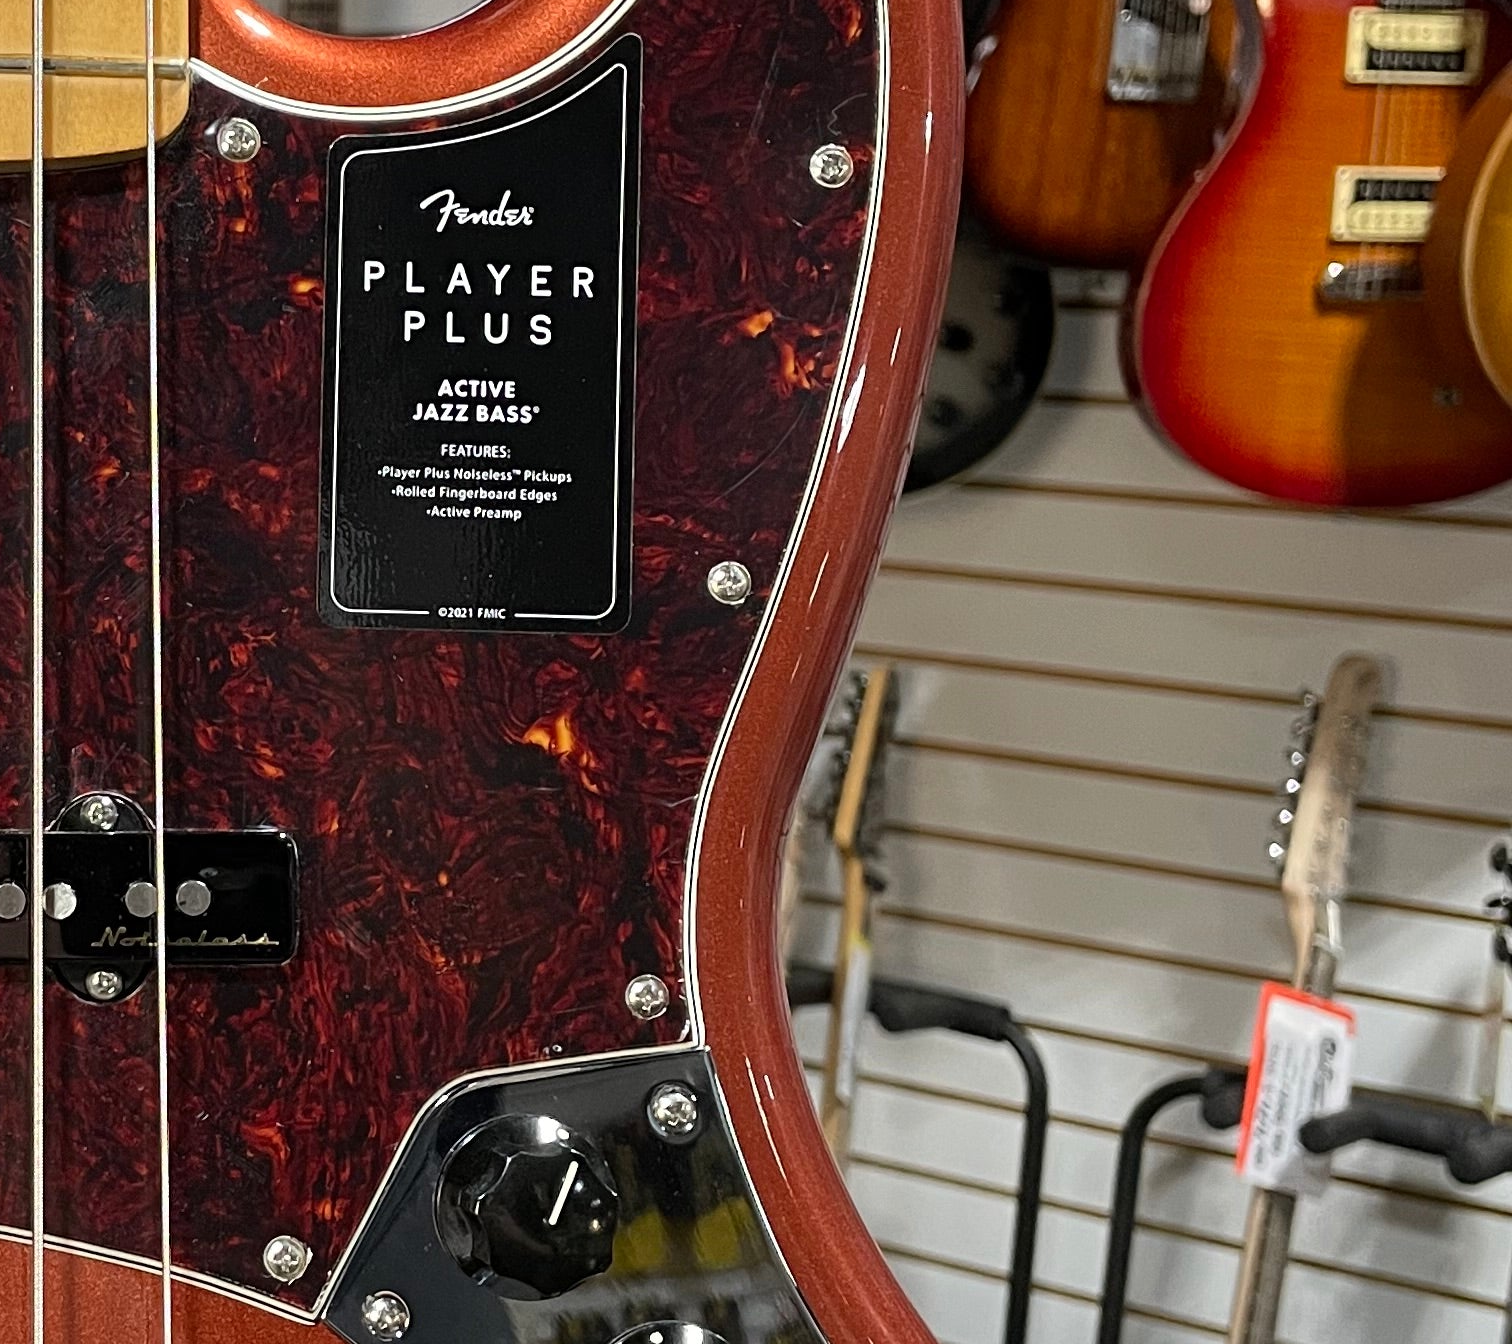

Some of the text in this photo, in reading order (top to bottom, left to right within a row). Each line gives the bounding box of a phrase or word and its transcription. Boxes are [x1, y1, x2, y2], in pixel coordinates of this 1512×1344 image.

[363, 260, 595, 299] PLAYER
[403, 310, 552, 346] PLUS
[437, 378, 516, 399] ACTIVE
[412, 402, 469, 423] JAZZ
[440, 443, 511, 459] FEATURES:
[424, 466, 451, 480] Plus
[523, 469, 573, 485] Pickups
[439, 486, 517, 502] Fingerboard
[519, 488, 558, 504] Edges
[473, 506, 522, 522] Preamp
[477, 607, 507, 620] FMIC
[90, 926, 280, 948] Noieless
